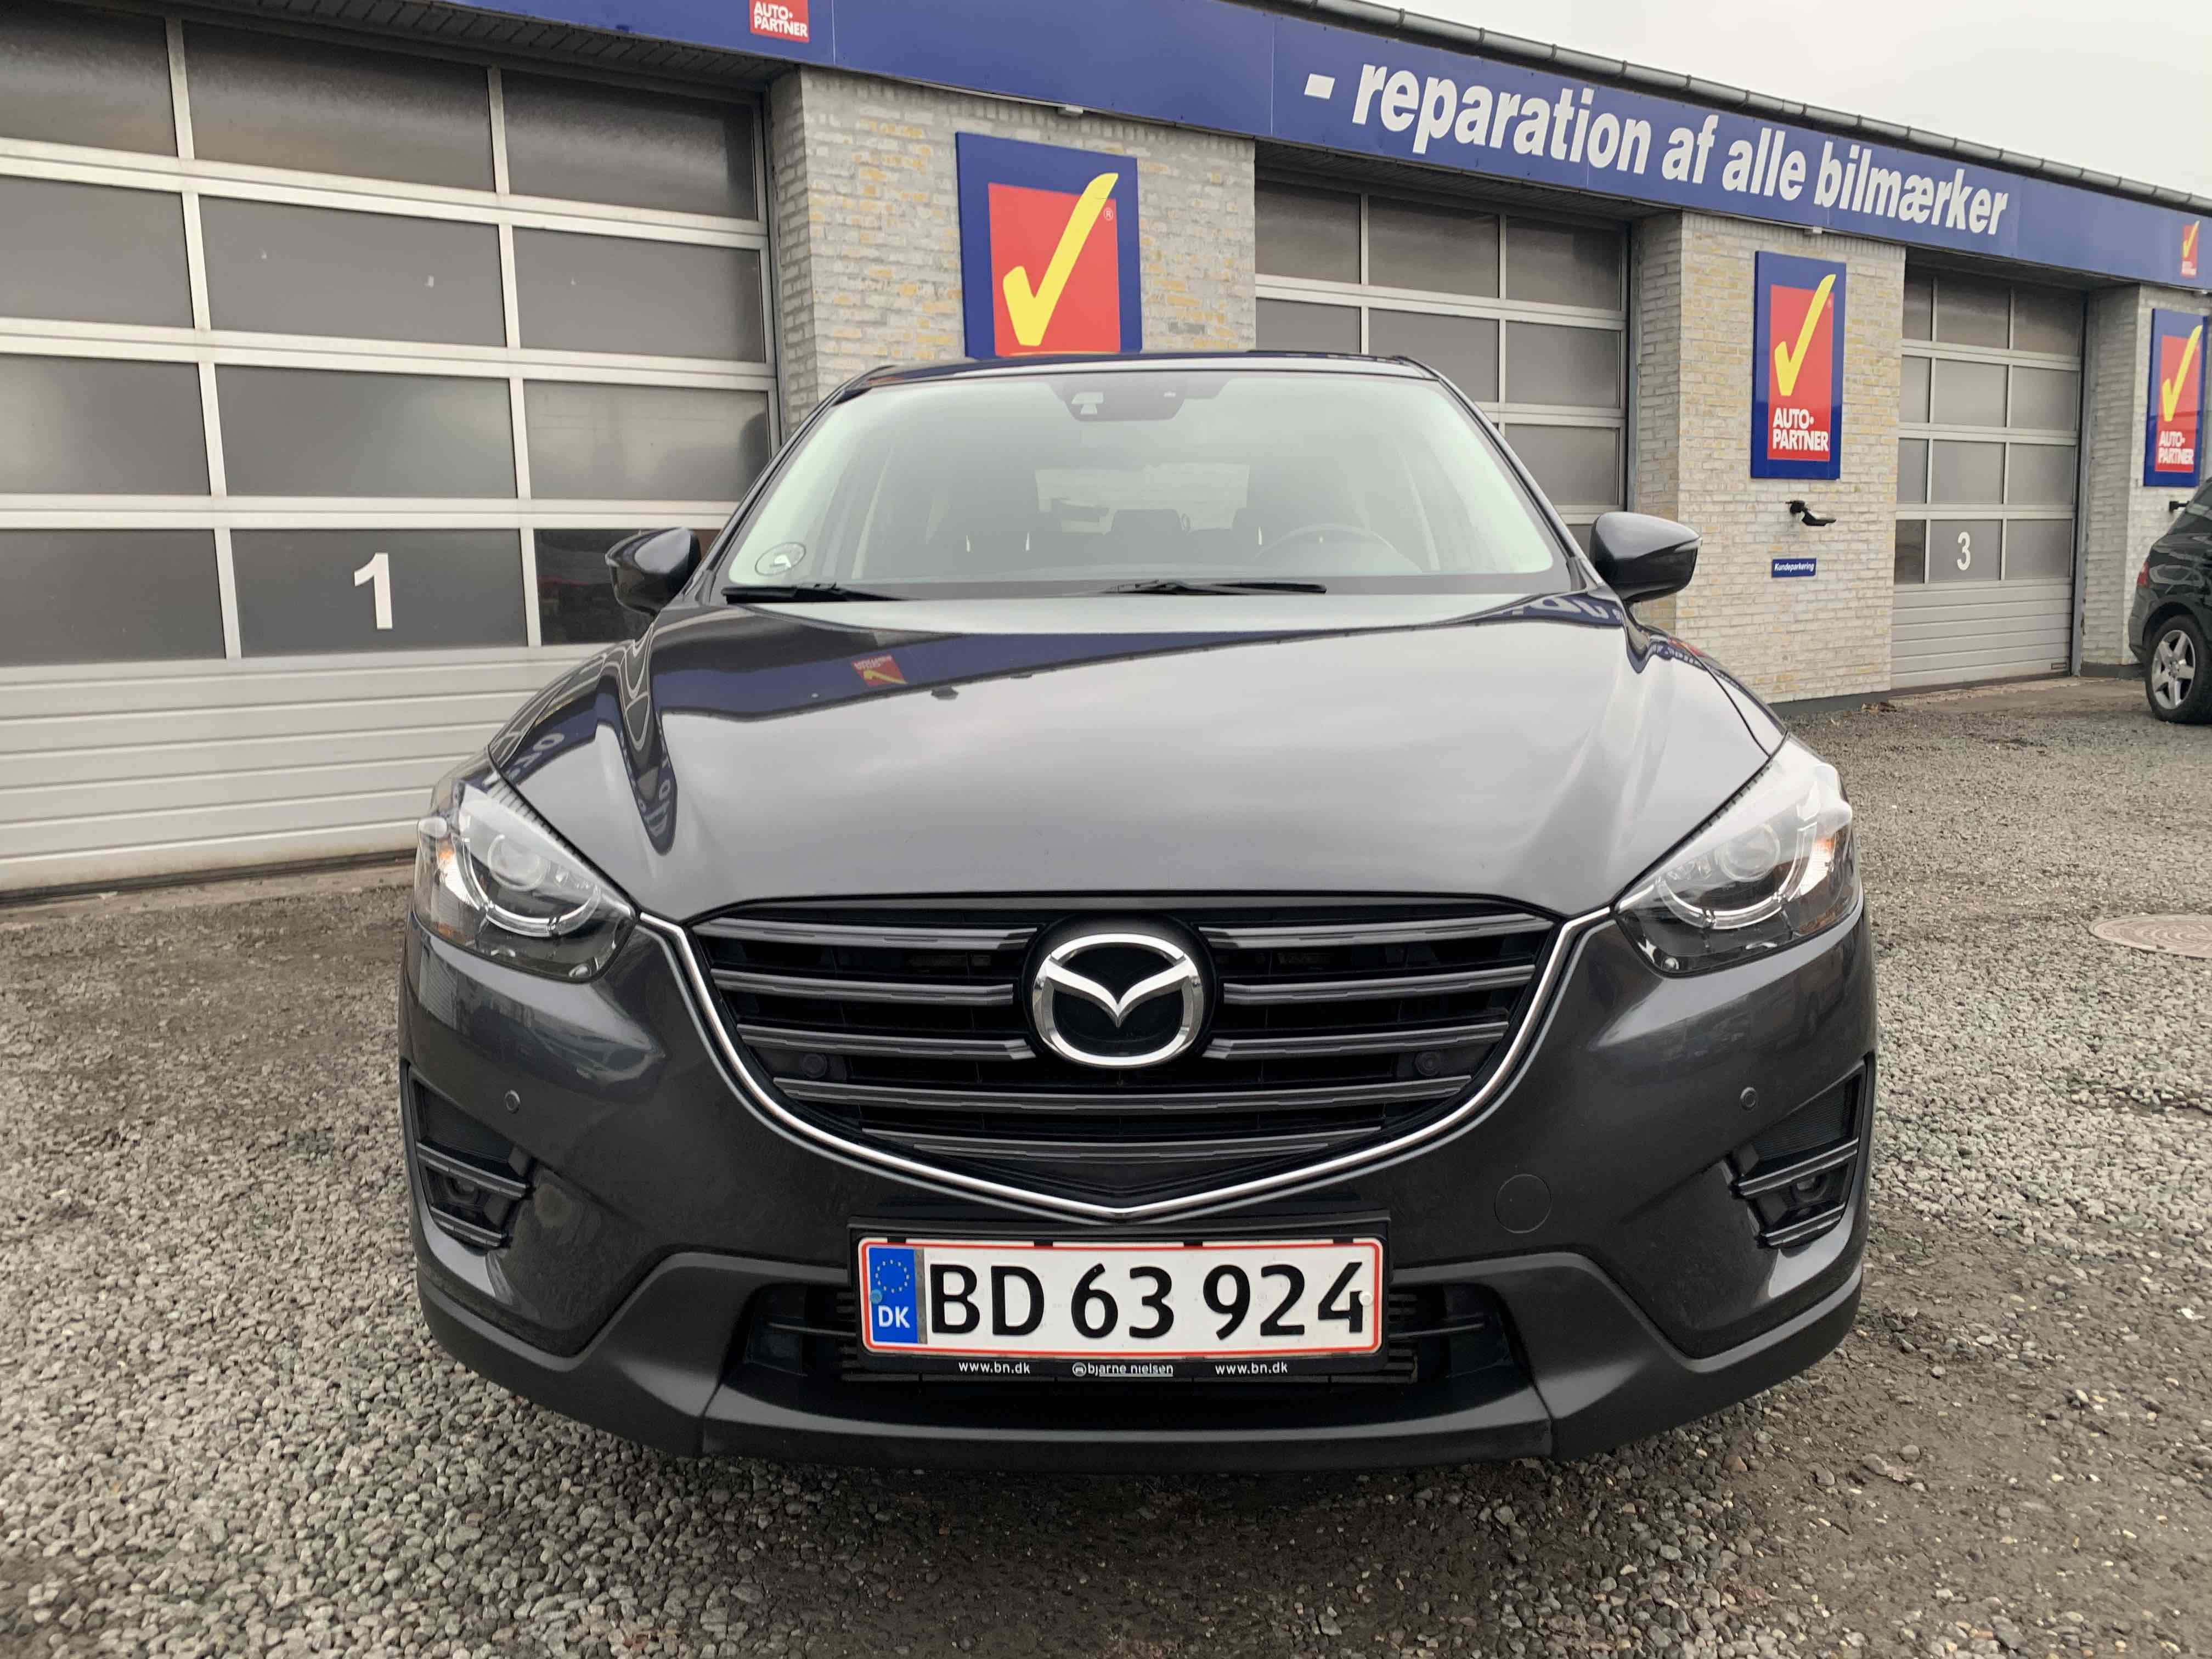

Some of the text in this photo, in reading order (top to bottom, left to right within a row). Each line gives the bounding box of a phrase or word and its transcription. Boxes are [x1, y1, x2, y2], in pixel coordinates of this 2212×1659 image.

[754, 15, 808, 38] PARTNER
[1352, 64, 1651, 174] reparation
[1662, 115, 1718, 184] af
[1722, 128, 1806, 201] alle
[1814, 141, 2008, 235] bilmærker
[1773, 429, 1829, 452] PARTNER
[2159, 447, 2194, 465] PARTNER
[1957, 532, 1971, 571] 3
[1774, 562, 1814, 572] Kundeparkering
[354, 552, 393, 630] 1
[929, 1261, 1364, 1340] BD 63 924
[878, 1306, 910, 1329] DK
[958, 1361, 1030, 1374] www.bn.dk
[1216, 1362, 1288, 1375] www.bn.dk
